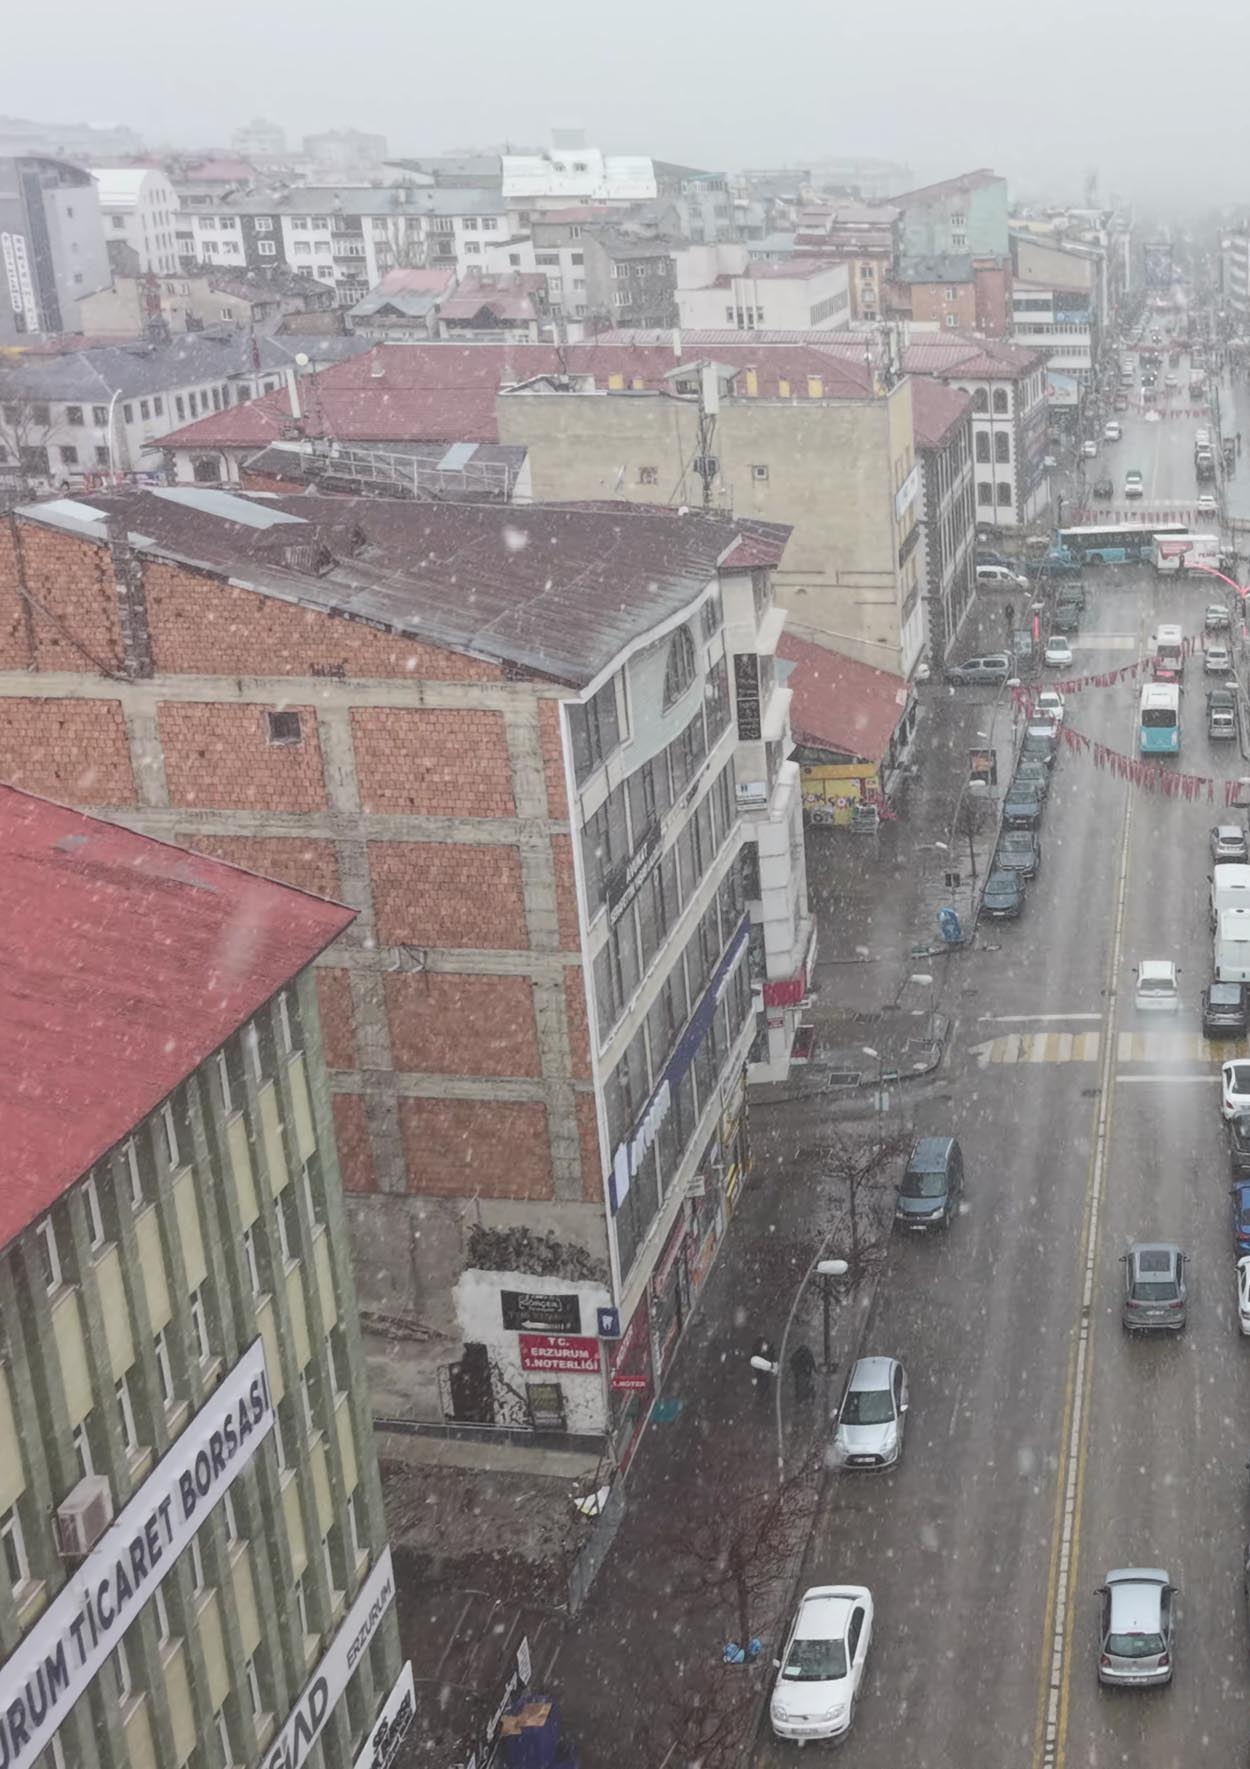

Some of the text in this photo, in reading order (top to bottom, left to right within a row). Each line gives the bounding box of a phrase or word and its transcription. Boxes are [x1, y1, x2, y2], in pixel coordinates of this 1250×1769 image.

[524, 1357, 598, 1370] 1.NOTERLİĞİ
[530, 1347, 590, 1359] ERZURUM
[69, 1494, 174, 1666] TİCARET
[179, 1370, 270, 1521] BORSASI
[346, 1577, 392, 1669] ERZURUM
